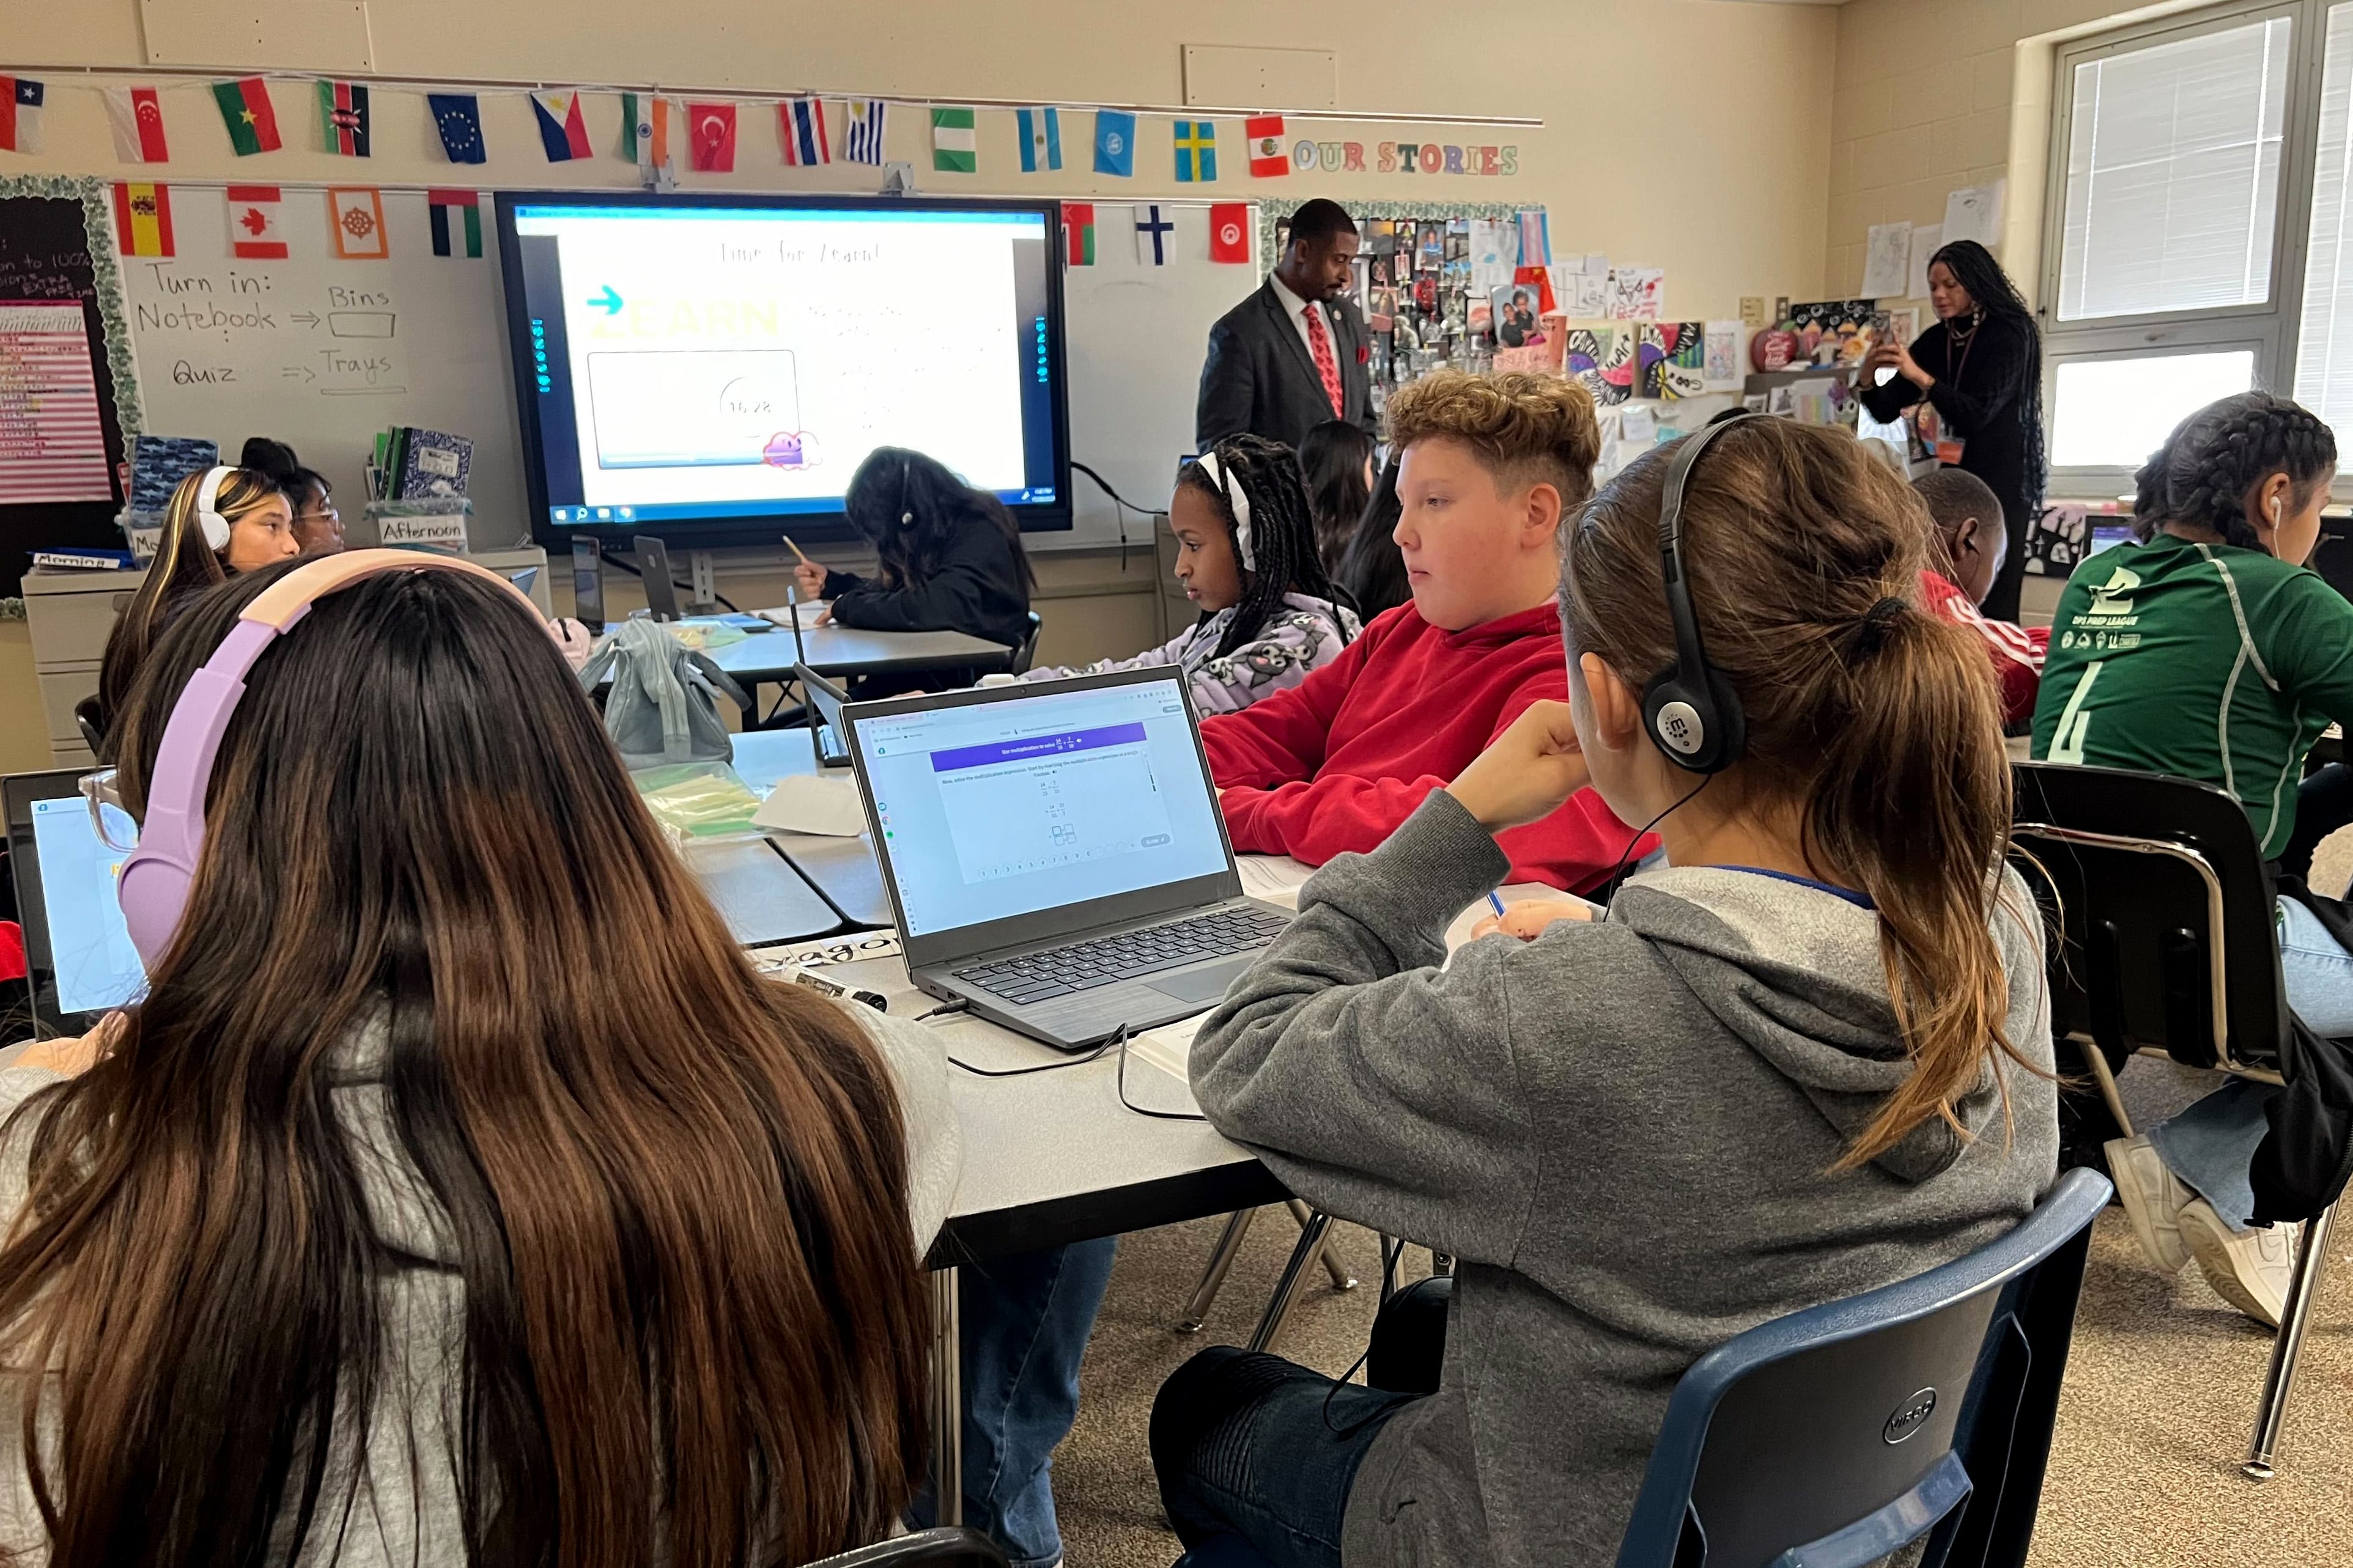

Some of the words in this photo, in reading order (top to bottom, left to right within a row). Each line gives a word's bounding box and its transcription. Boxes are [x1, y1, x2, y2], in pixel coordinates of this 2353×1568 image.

[1293, 139, 1367, 173] OUR
[1377, 141, 1518, 176] STORIES
[145, 262, 212, 295] Turn
[230, 271, 271, 293] in:
[328, 285, 390, 307] Bins
[138, 301, 276, 331] Notebook
[173, 359, 237, 385] Quiz
[319, 349, 392, 385] Trays
[383, 521, 461, 540] Afternoon
[38, 553, 105, 568] Morning
[2105, 616, 2139, 626] LEAGUE
